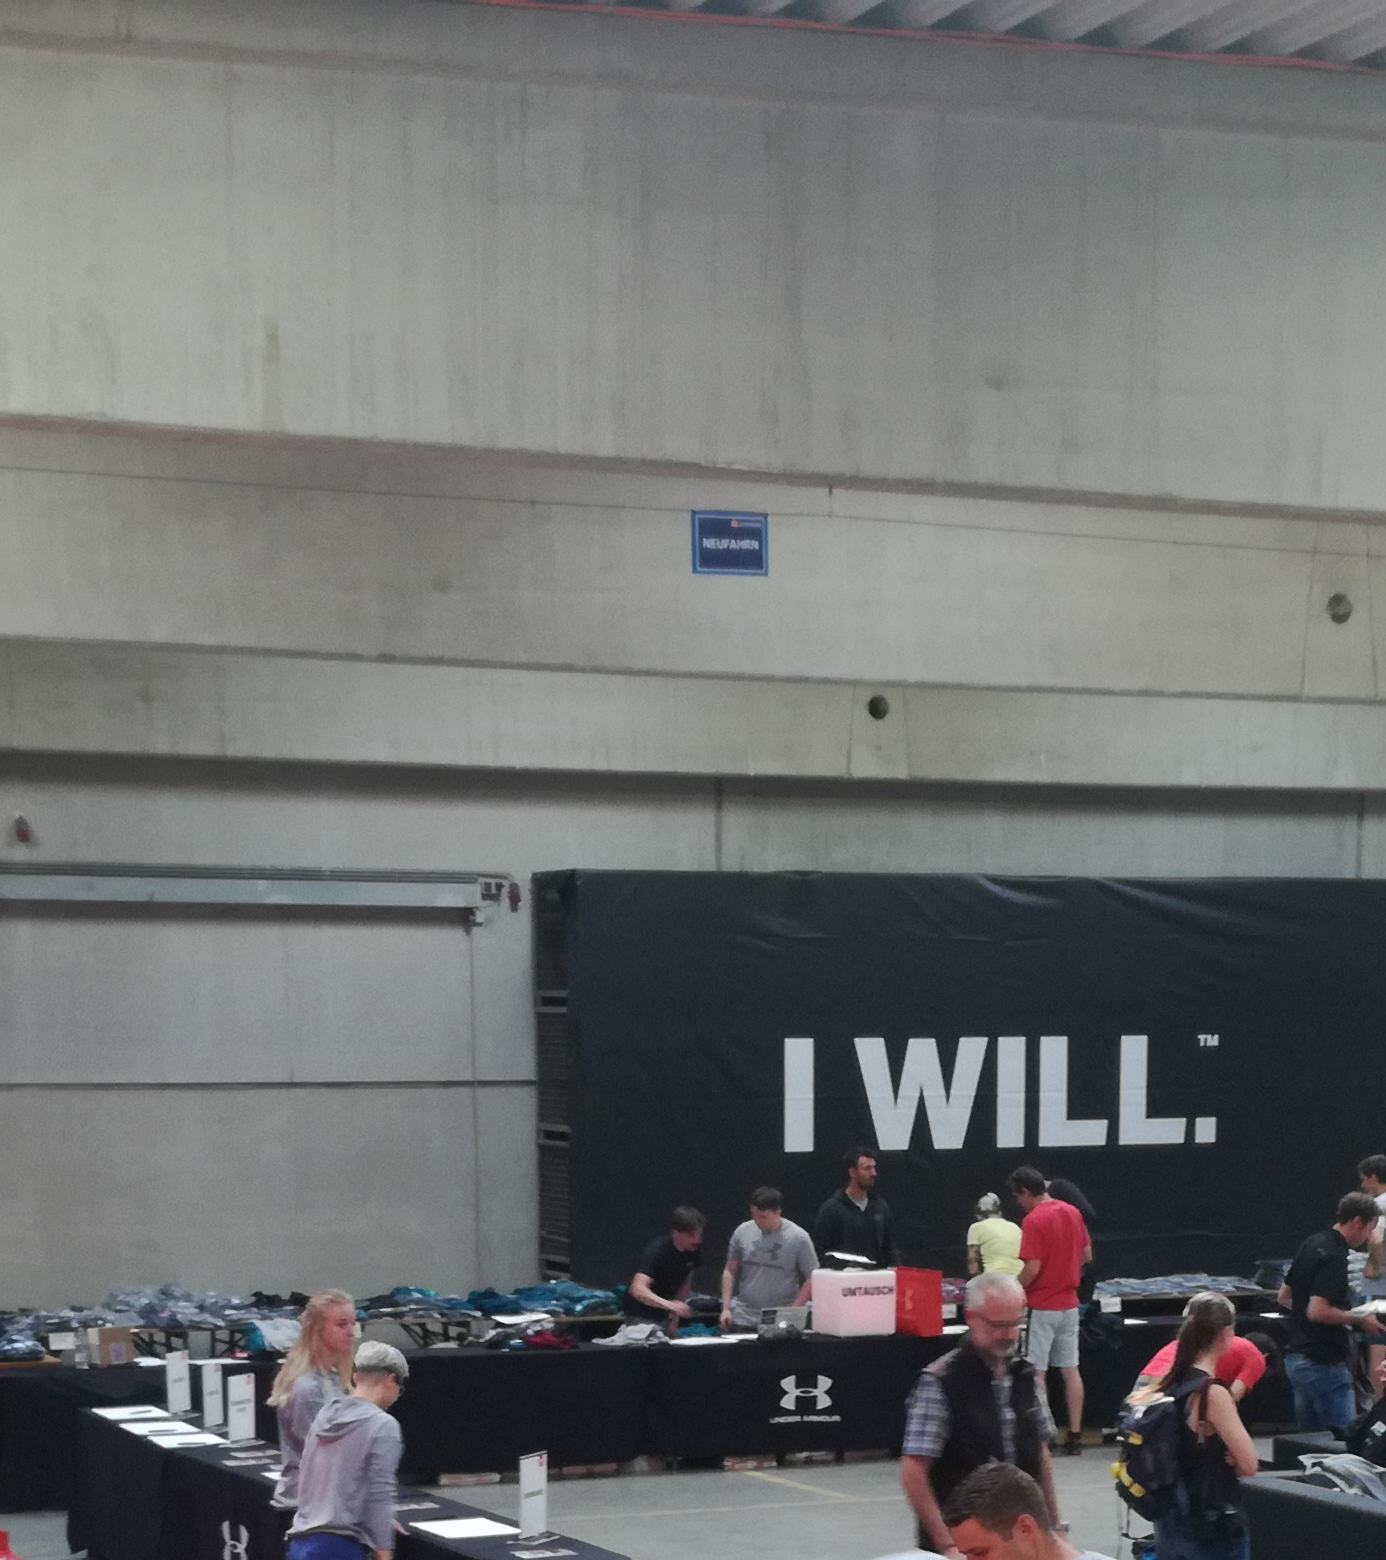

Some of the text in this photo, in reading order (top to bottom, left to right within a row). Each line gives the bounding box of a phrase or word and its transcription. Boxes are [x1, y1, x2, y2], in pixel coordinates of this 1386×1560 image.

[702, 537, 759, 550] NEUFAHRN
[784, 1037, 814, 1152] I
[853, 1035, 1217, 1150] WILL.
